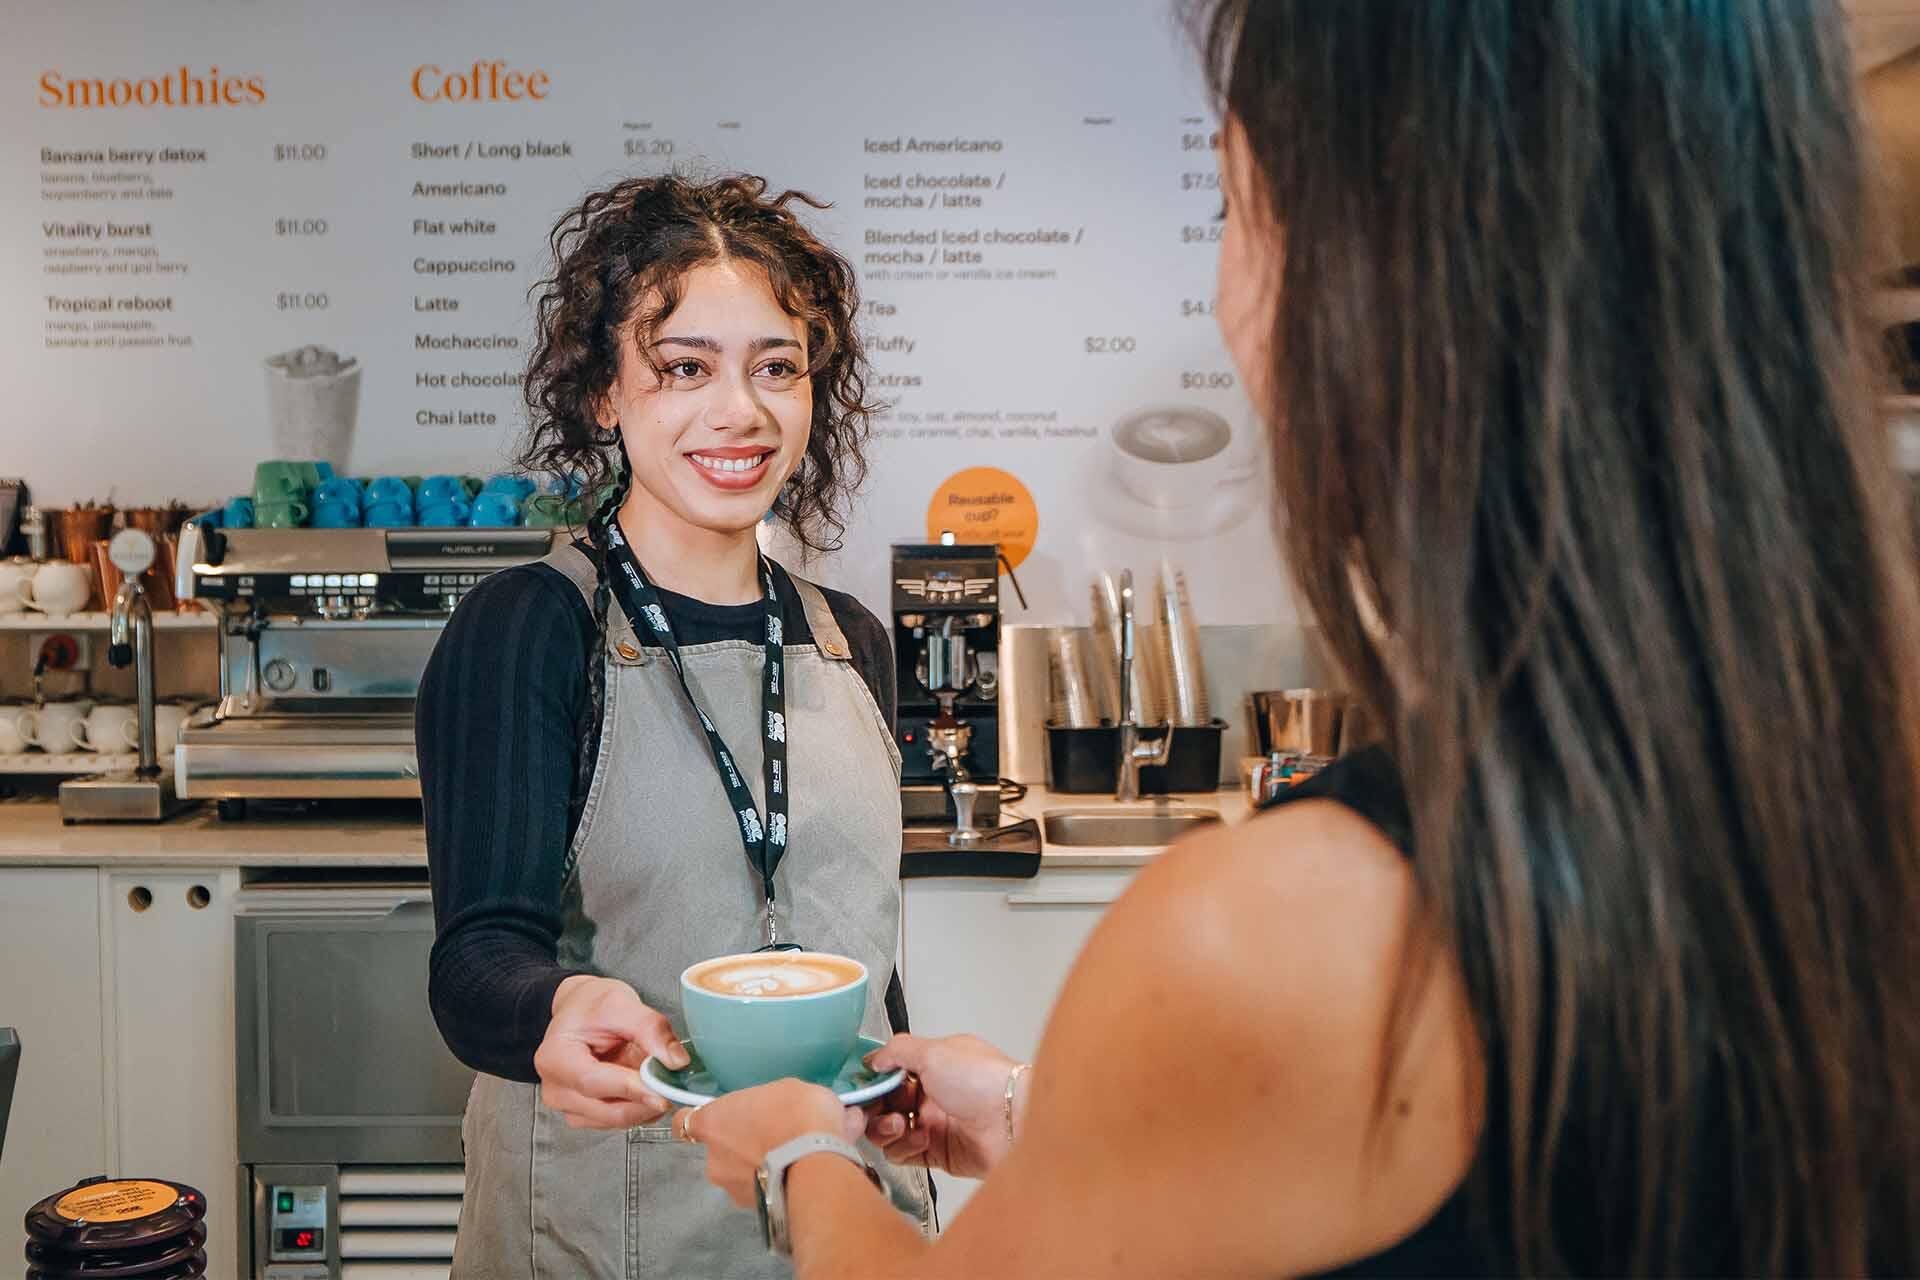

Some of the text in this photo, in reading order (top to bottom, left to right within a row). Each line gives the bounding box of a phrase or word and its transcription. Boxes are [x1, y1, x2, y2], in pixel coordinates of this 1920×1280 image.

[39, 67, 265, 108] Smoothies
[412, 60, 550, 101] Coffee
[412, 142, 572, 159] Short / Long black
[624, 140, 674, 155] $5.20
[864, 139, 1003, 152] Iced Americano
[1181, 134, 1220, 151] $6.
[41, 147, 207, 164] Banana berry detox
[274, 144, 325, 161] $11.00
[412, 182, 506, 197] Americano
[864, 174, 1005, 189] Iced chocolate /
[865, 194, 982, 209] mocha / latte
[42, 222, 151, 239] Vitality burst
[275, 219, 326, 235] $11.00
[413, 221, 496, 235] Flat white
[865, 229, 1083, 245] Blended Iced chocolate /
[865, 251, 982, 265] mocha / latte
[414, 258, 514, 276] Cappuccino
[45, 296, 172, 313] Tropical reboot
[277, 293, 328, 310] $11.00
[415, 298, 459, 312] Latte
[866, 301, 896, 316] Tea
[1181, 299, 1217, 316] $4.
[416, 335, 519, 349] Mochaccino
[865, 336, 914, 352] Fluffy
[1085, 337, 1135, 353] $2.00
[416, 372, 524, 387] Hot chocolat
[865, 373, 921, 387] Extras
[1181, 372, 1232, 389] $0.90
[417, 411, 496, 426] Chai latte
